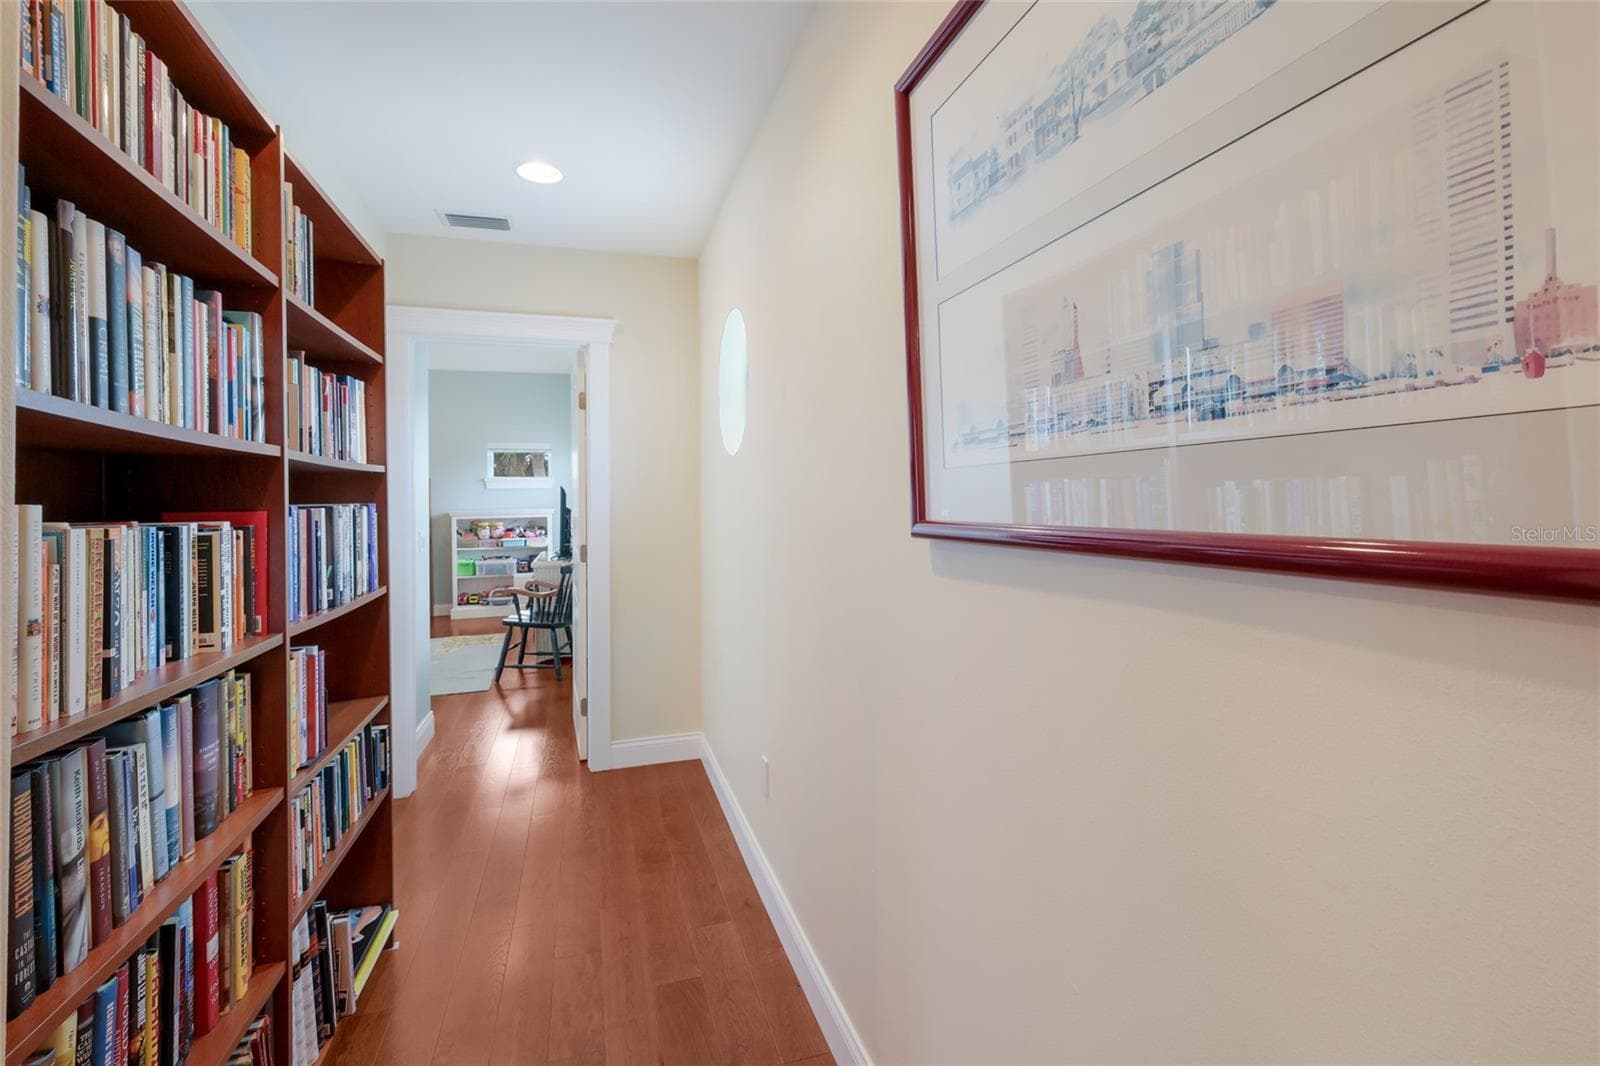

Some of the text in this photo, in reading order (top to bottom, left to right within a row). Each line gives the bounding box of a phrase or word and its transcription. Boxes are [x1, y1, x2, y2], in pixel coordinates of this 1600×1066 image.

[74, 769, 82, 798] Keith
[75, 801, 84, 850] Richards
[14, 790, 33, 919] NORMAN MAILER
